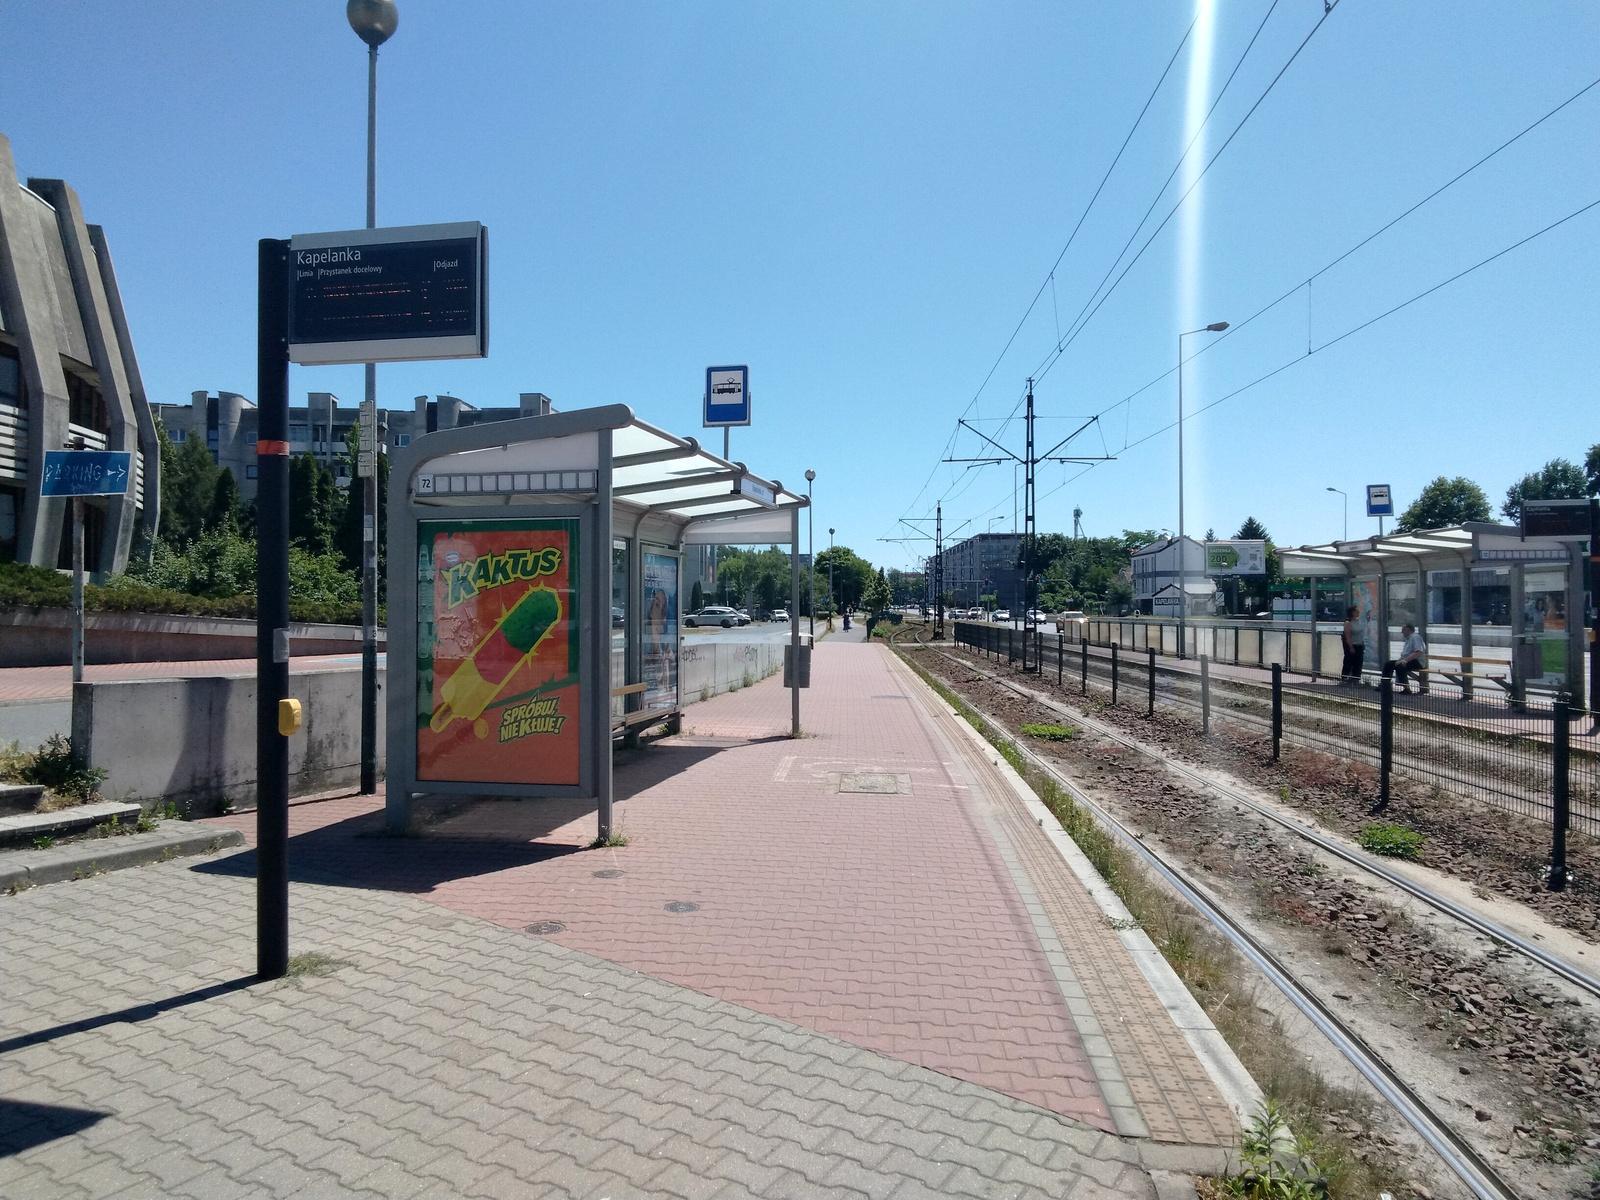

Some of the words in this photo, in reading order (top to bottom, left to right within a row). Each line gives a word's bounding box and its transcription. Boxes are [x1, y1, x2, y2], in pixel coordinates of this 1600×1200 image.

[297, 247, 361, 267] Kapelanka
[320, 267, 352, 276] Przystanek
[353, 265, 383, 273] docelowy
[421, 478, 431, 489] 72
[444, 548, 561, 607] KAKTUS
[500, 722, 519, 742] NIE
